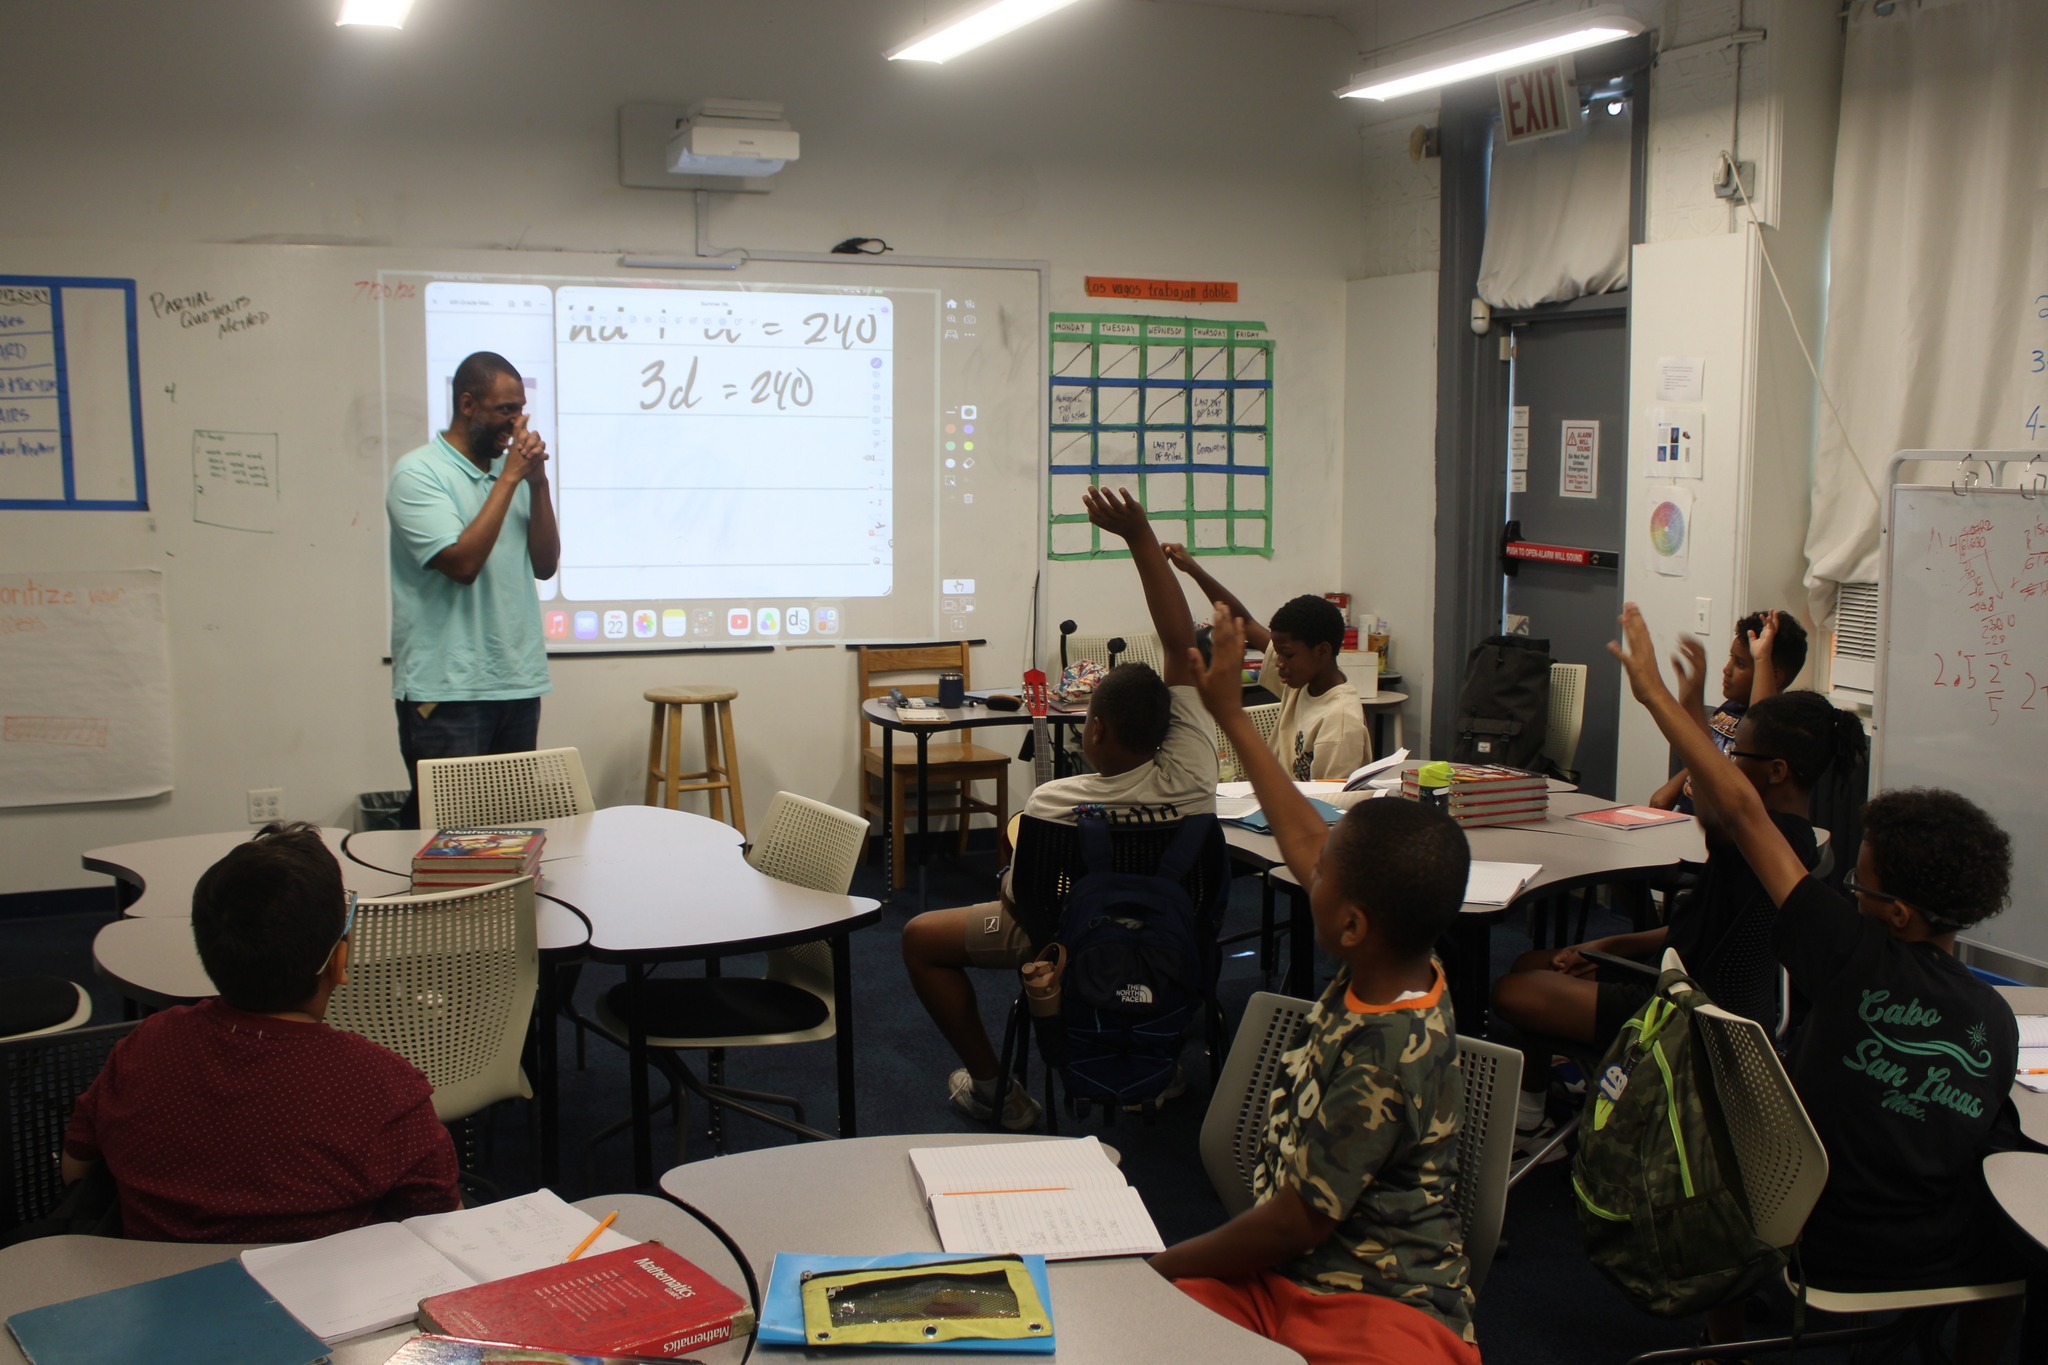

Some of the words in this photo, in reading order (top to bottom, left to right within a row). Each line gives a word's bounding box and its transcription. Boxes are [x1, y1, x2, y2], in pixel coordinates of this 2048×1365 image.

[1504, 66, 1560, 136] EXIT
[1147, 284, 1196, 300] trabajan
[1202, 285, 1230, 299] doble
[803, 312, 877, 350] 240
[1055, 323, 1085, 333] MONDAY
[1101, 324, 1136, 336] TUESDAY
[1194, 328, 1227, 339] THURSDAY
[1235, 332, 1260, 340] FRIDAY
[640, 355, 703, 411] 3d
[750, 367, 813, 411] 240
[1506, 546, 1518, 555] PUSH
[1519, 547, 1525, 556] TO
[1526, 548, 1554, 559] OPEN-ALARM
[1555, 552, 1565, 560] WILL
[1566, 552, 1583, 562] SOUND
[608, 621, 624, 634] 22
[1859, 989, 1942, 1027] Cabo
[1843, 1039, 1908, 1087] San
[1908, 1066, 1983, 1119] Lucas
[634, 1257, 696, 1298] Mathematics
[664, 1325, 732, 1353] Mathematics
